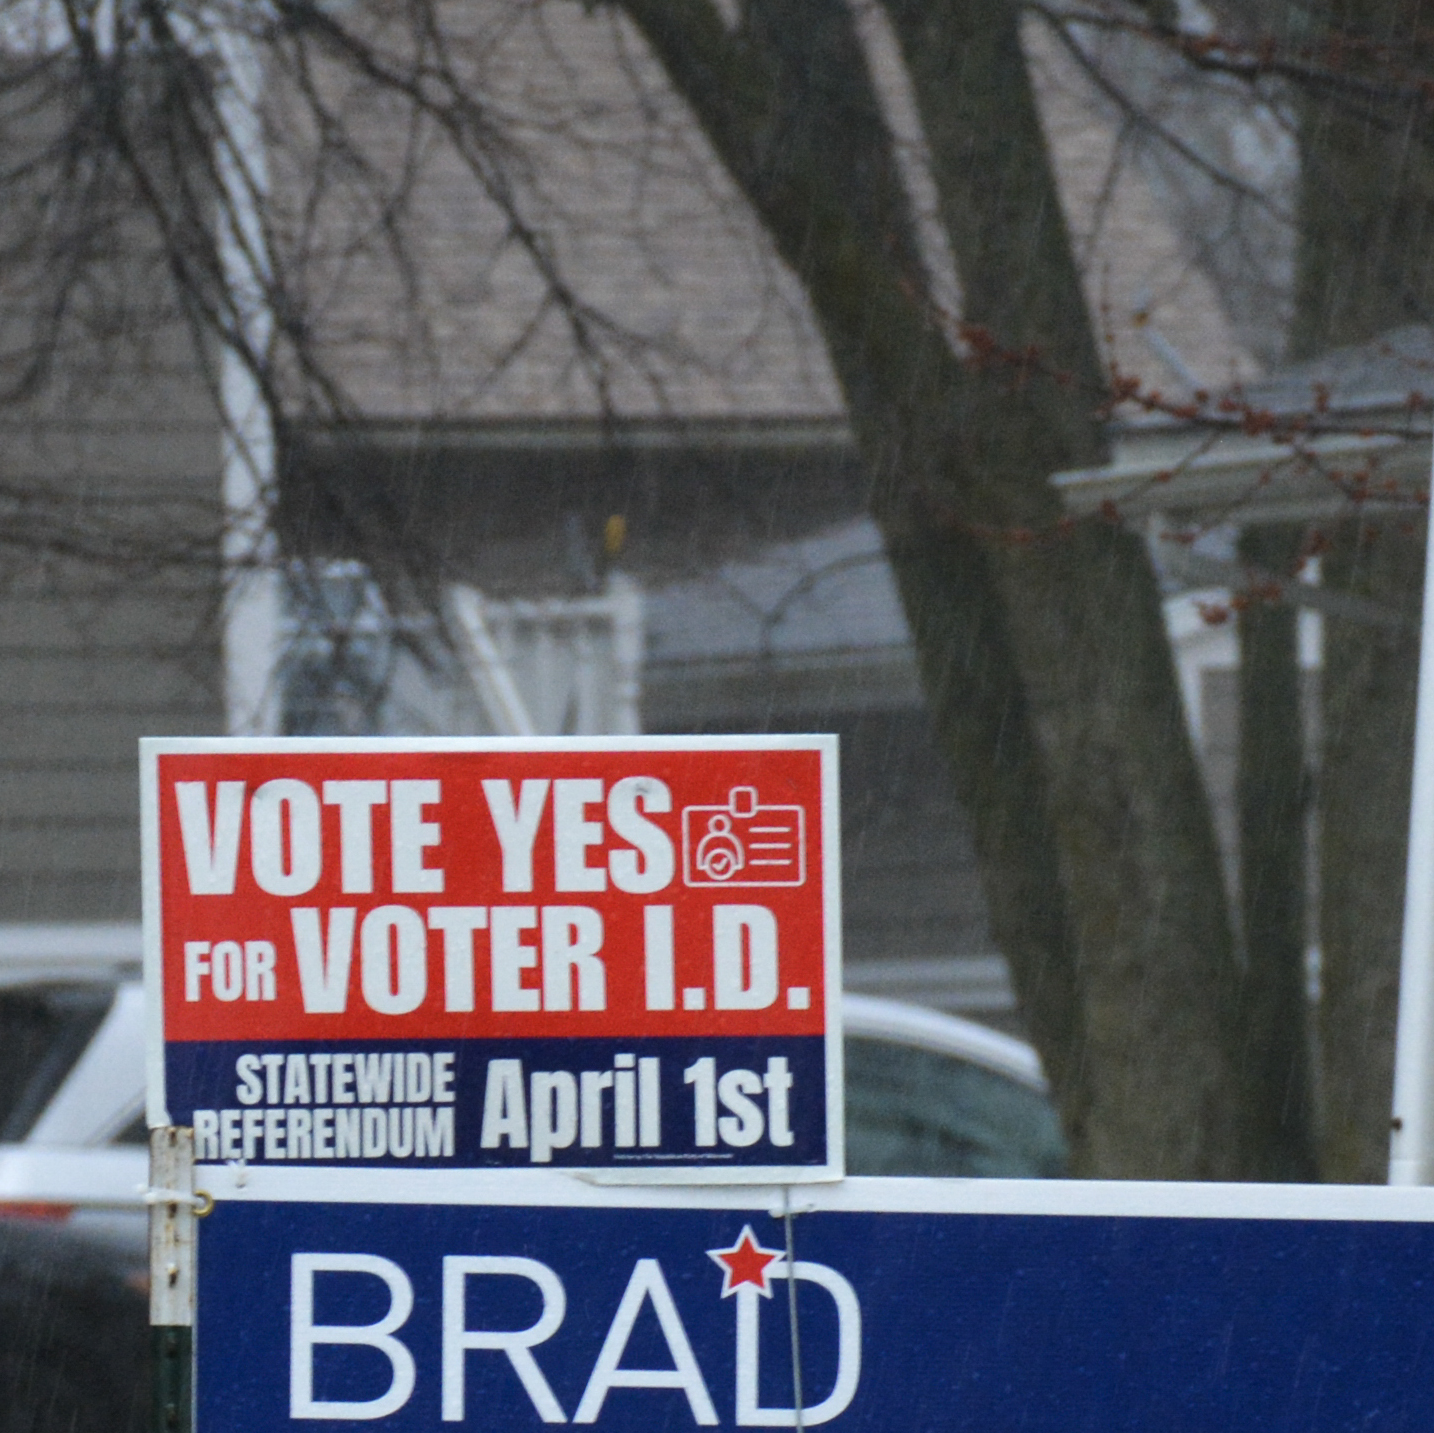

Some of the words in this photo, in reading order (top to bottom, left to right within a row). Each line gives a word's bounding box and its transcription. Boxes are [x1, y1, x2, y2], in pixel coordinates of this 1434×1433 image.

[174, 778, 446, 897] VOTE
[481, 775, 676, 895] YES
[184, 940, 277, 1003] FOR
[290, 904, 607, 1015] VOTER
[643, 904, 811, 1011] I.D.
[192, 1106, 455, 1161] REFERENDUM
[235, 1052, 456, 1105] STATEWIDE
[480, 1053, 661, 1163] April
[683, 1056, 795, 1148] 1st
[289, 1252, 862, 1428] BRAD
